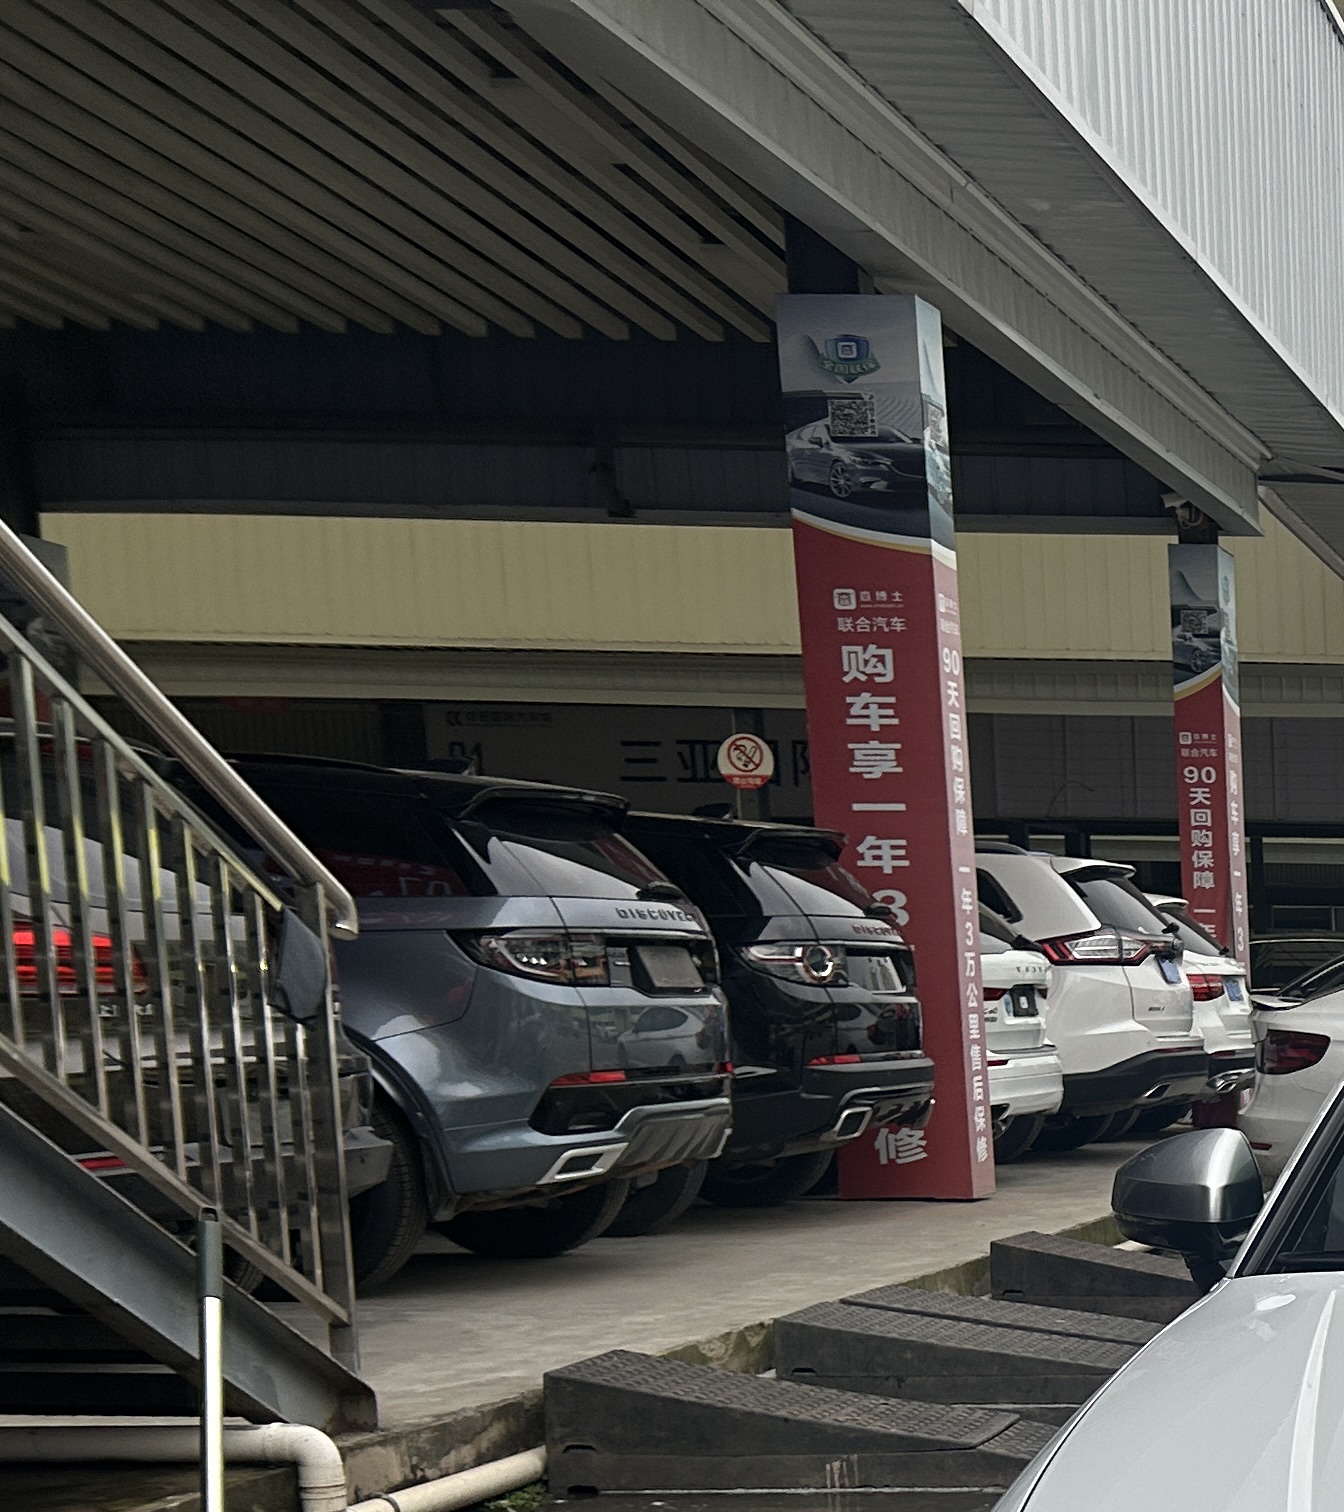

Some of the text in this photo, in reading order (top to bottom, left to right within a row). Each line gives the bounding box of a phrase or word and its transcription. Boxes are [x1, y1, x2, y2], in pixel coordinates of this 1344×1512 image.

[837, 617, 907, 632] 联合汽车
[1183, 766, 1218, 889] 90天回购保障
